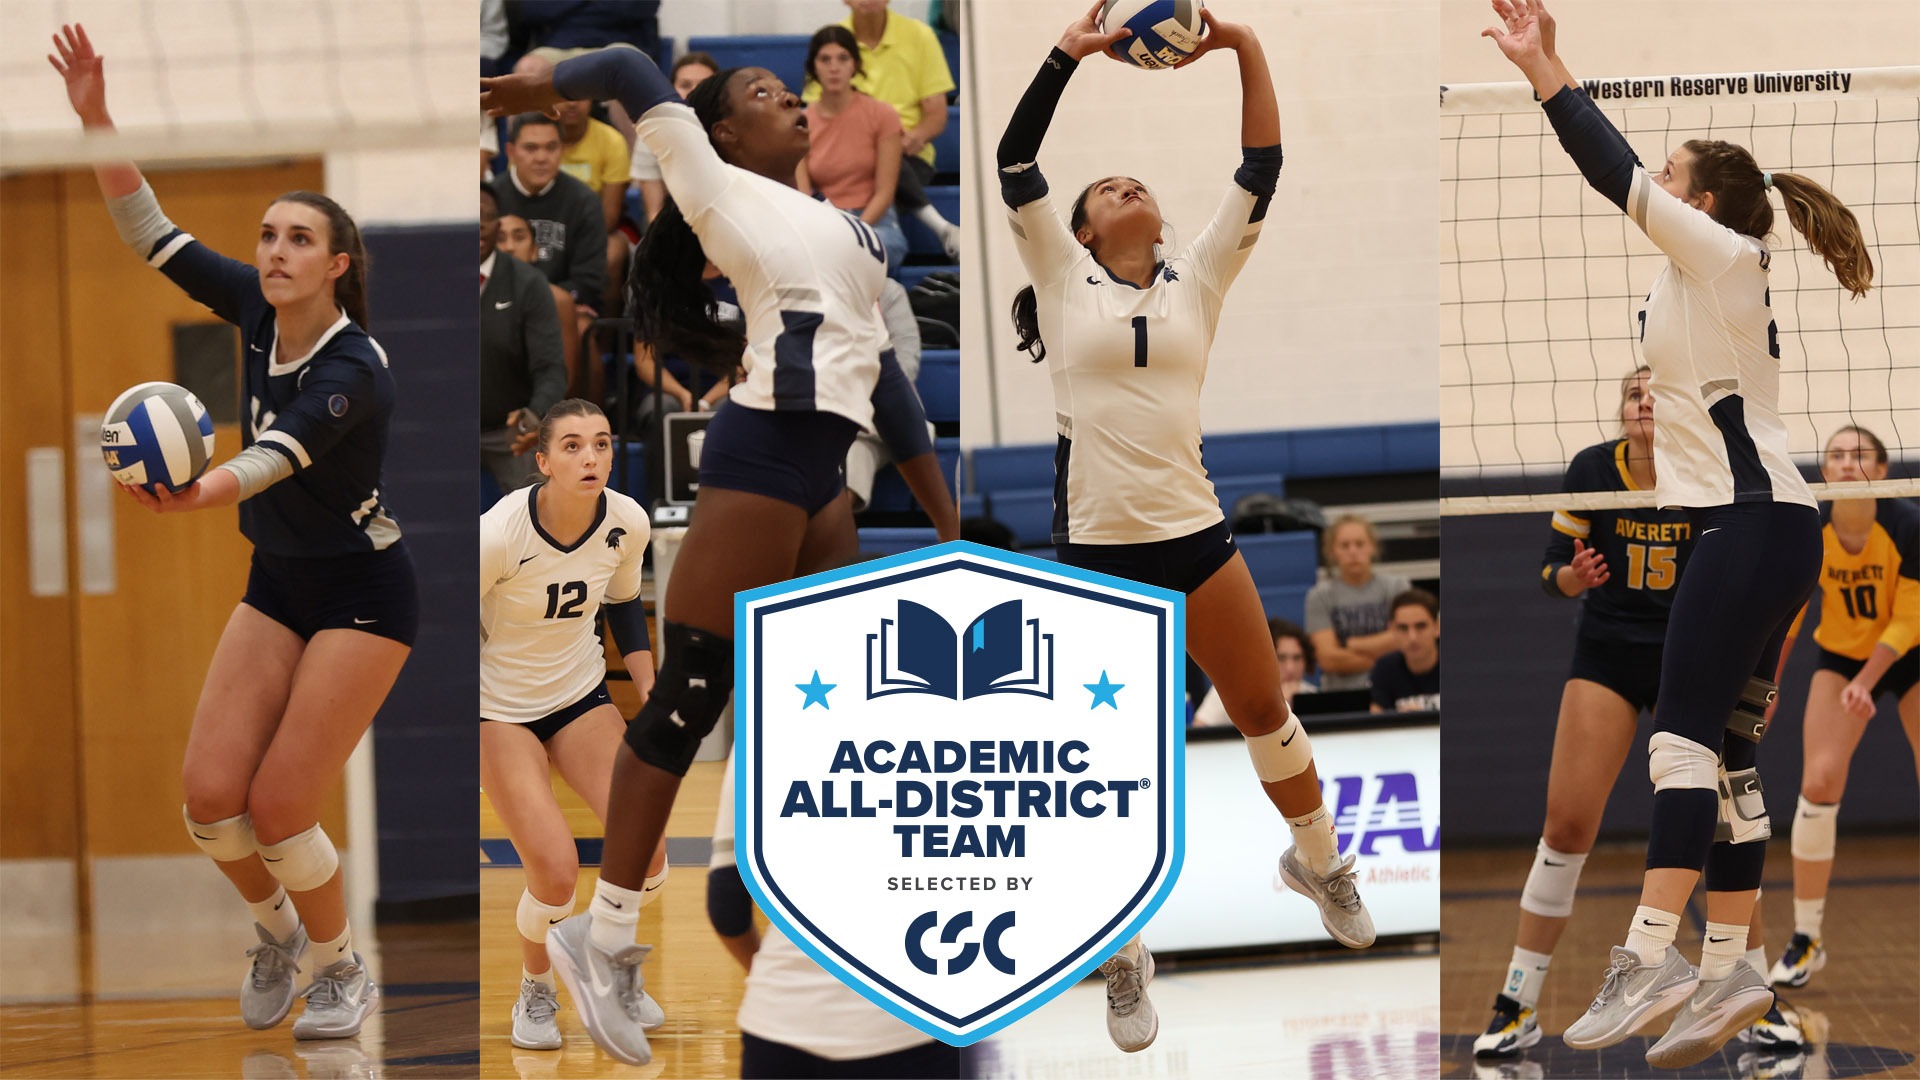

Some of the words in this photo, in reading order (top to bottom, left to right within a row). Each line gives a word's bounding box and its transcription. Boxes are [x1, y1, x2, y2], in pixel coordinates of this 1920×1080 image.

[1582, 79, 1665, 100] Western
[1670, 76, 1748, 97] Reserve
[1754, 71, 1851, 94] University
[1131, 316, 1148, 367] 1
[1615, 518, 1691, 541] AVERETT
[1626, 543, 1677, 590] 15
[544, 581, 588, 619] 12
[1840, 585, 1877, 619] 10
